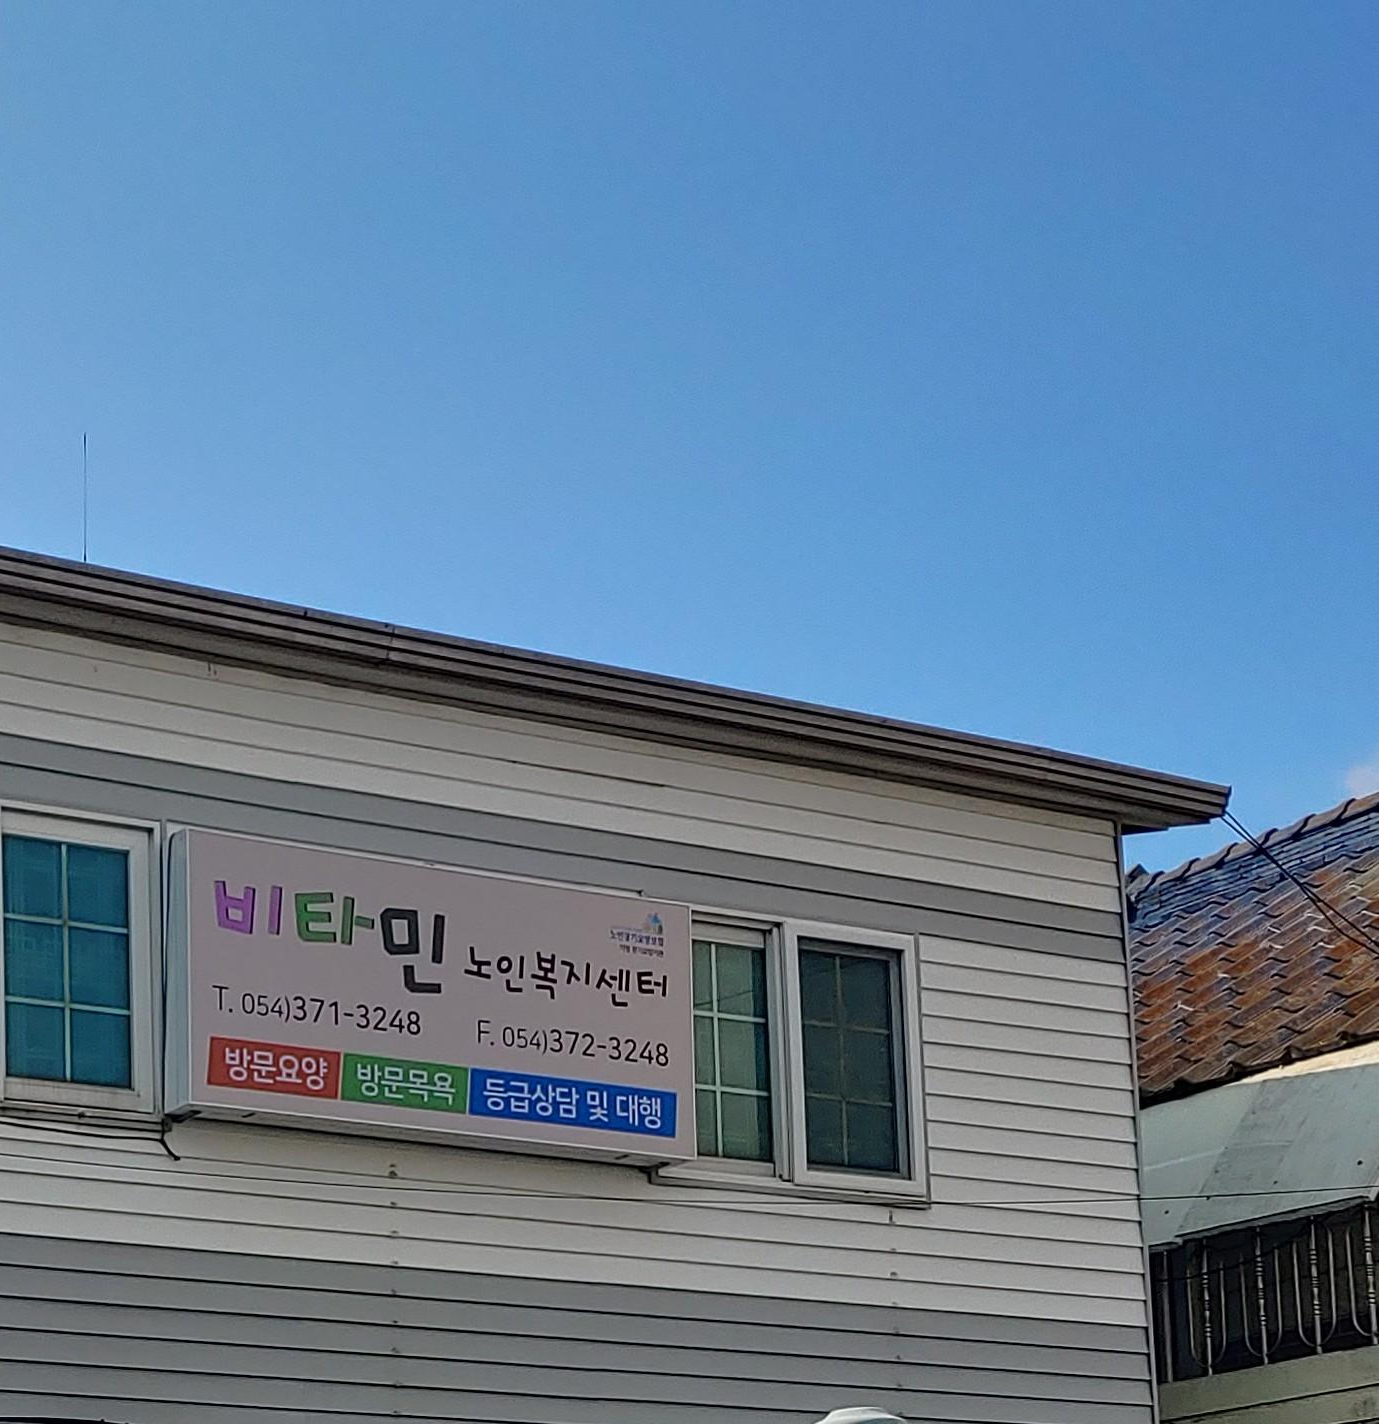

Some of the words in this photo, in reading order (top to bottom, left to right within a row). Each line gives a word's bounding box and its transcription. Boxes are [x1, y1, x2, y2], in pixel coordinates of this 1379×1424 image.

[213, 879, 446, 995] 비타민
[463, 946, 669, 1008] 노인복지센터
[224, 1045, 329, 1091] 방문요양
[356, 1062, 457, 1106] 방문목욕
[482, 1077, 580, 1119] 등급상담
[586, 1091, 608, 1121] 및
[615, 1093, 662, 1130] 대행
